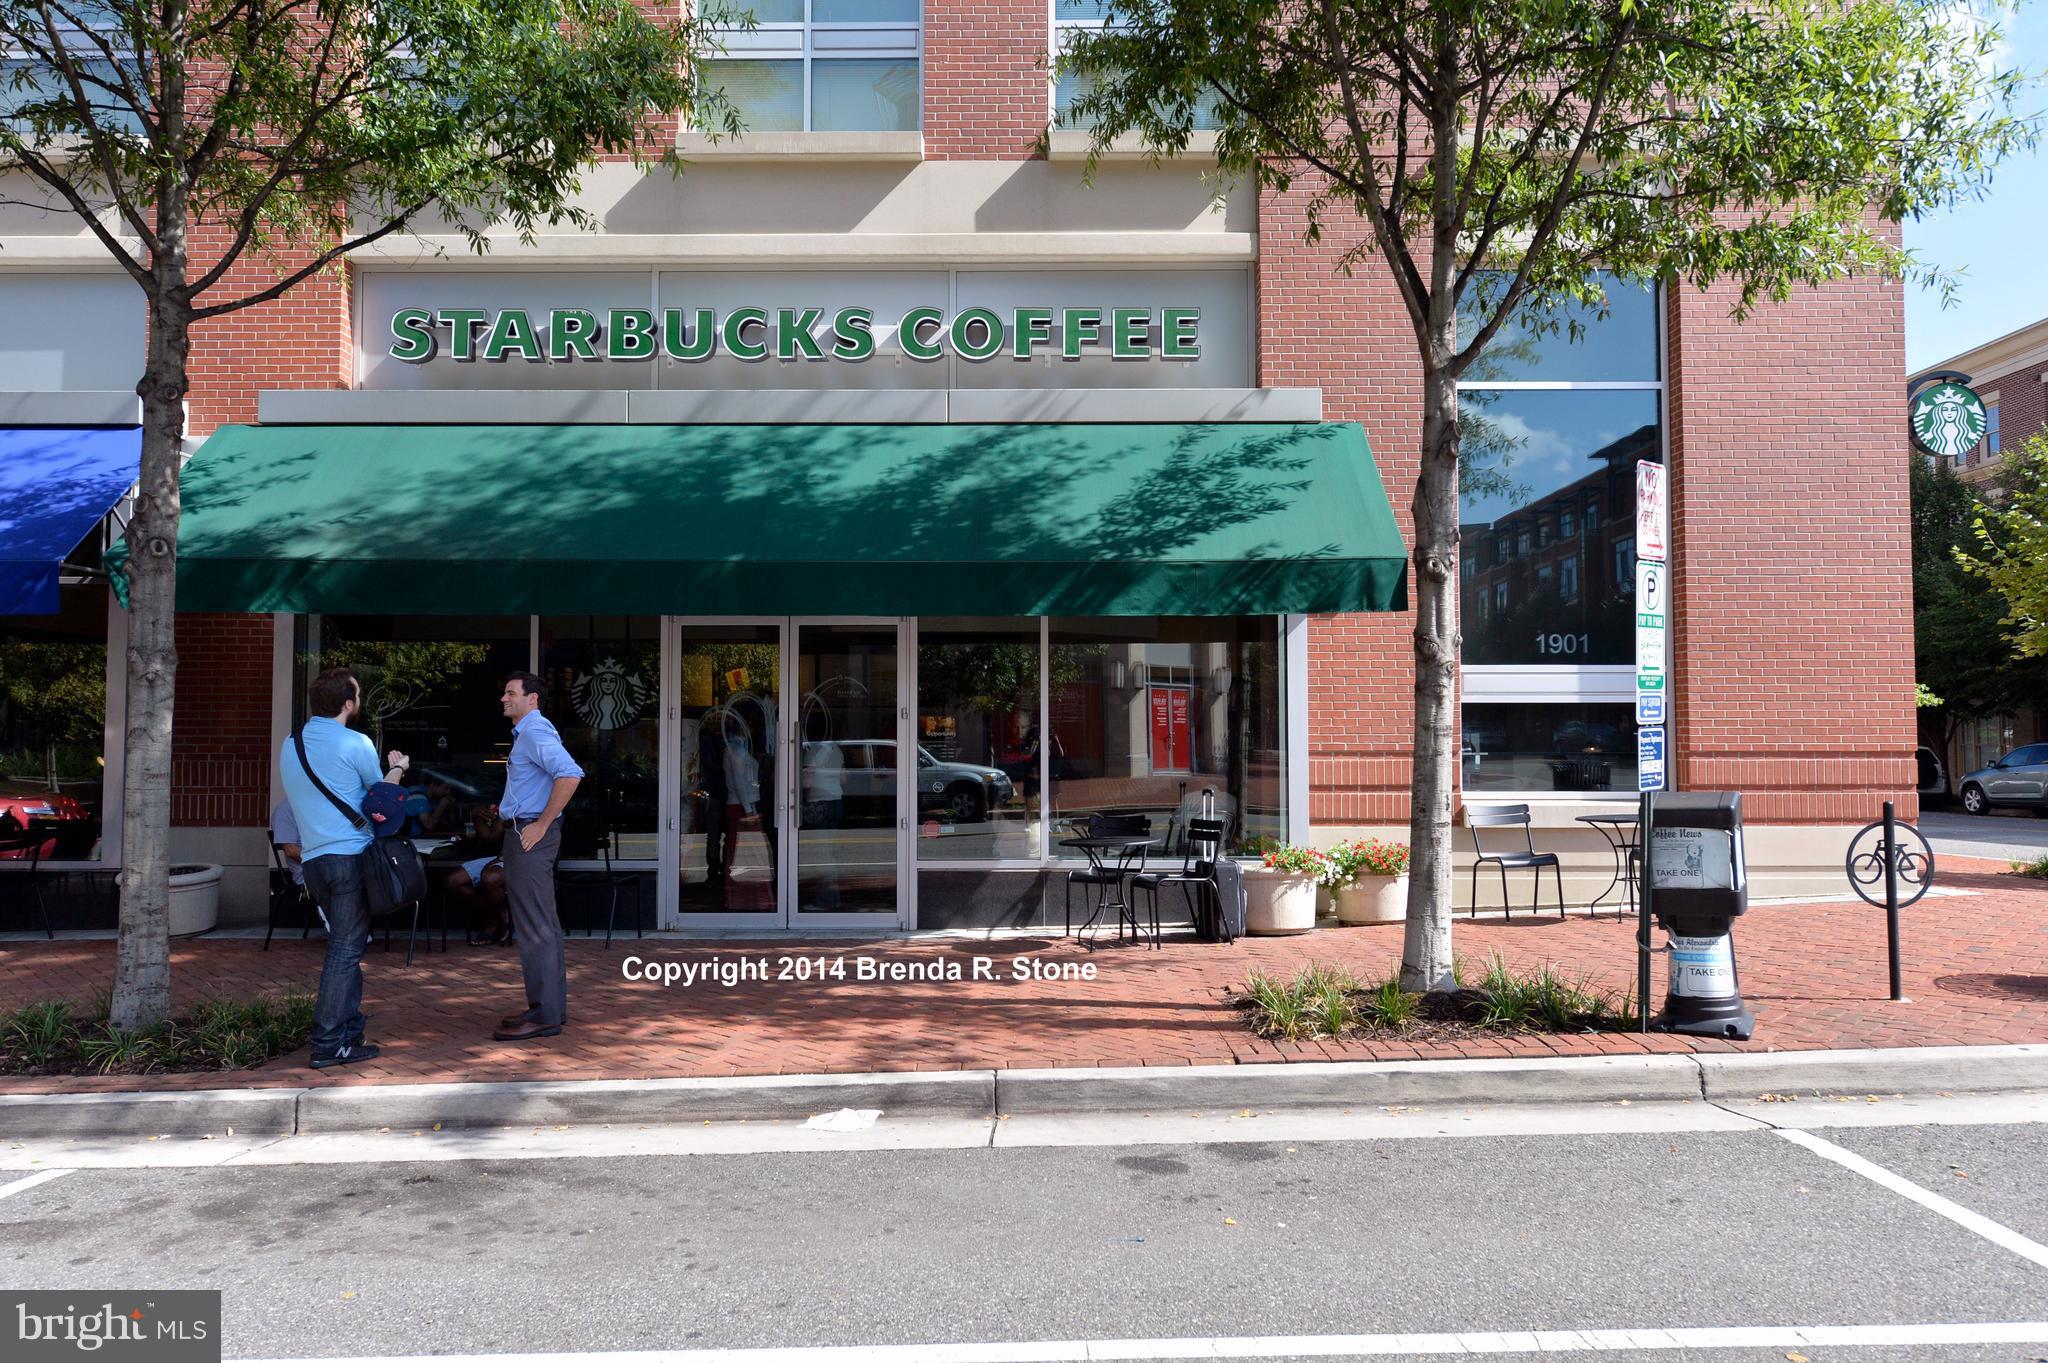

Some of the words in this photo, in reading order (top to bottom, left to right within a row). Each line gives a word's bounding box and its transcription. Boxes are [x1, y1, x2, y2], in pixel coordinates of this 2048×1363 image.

[388, 306, 876, 362] STARBUCKS
[897, 306, 1202, 362] COFFEE
[1644, 470, 1657, 489] NO
[1647, 578, 1656, 605] P
[1536, 633, 1590, 654] 1901
[1679, 828, 1703, 839] News
[1656, 869, 1678, 877] TAKE
[1680, 869, 1700, 877] ONE
[1689, 967, 1715, 977] TAKE
[1717, 968, 1731, 977] ONE
